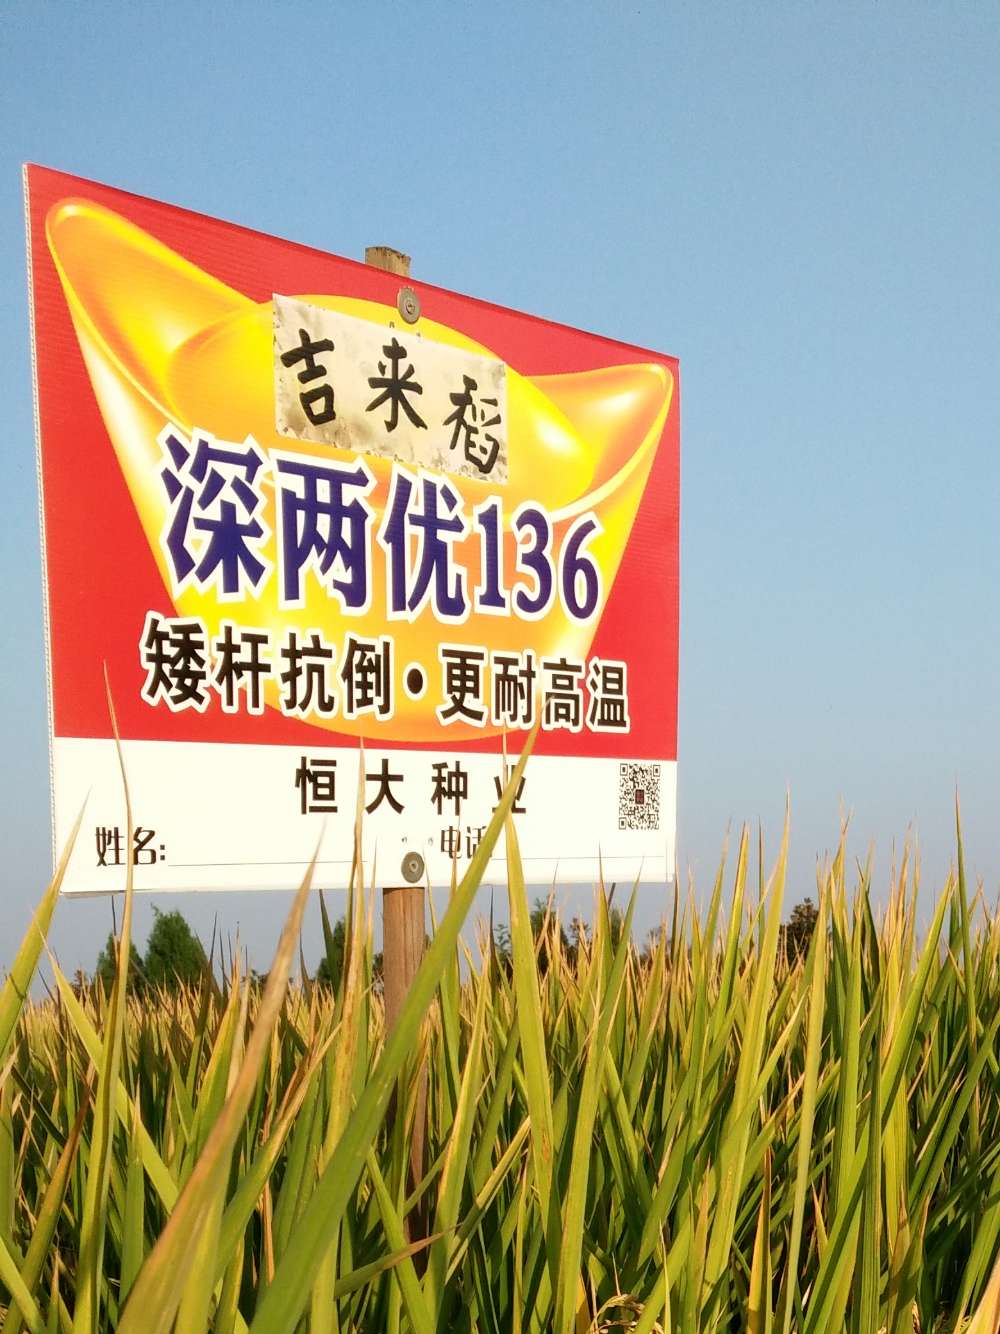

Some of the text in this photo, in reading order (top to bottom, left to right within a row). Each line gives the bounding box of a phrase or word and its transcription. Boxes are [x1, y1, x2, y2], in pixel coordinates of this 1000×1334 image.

[281, 328, 505, 474] 吉来稻
[160, 435, 602, 620] 深两优136
